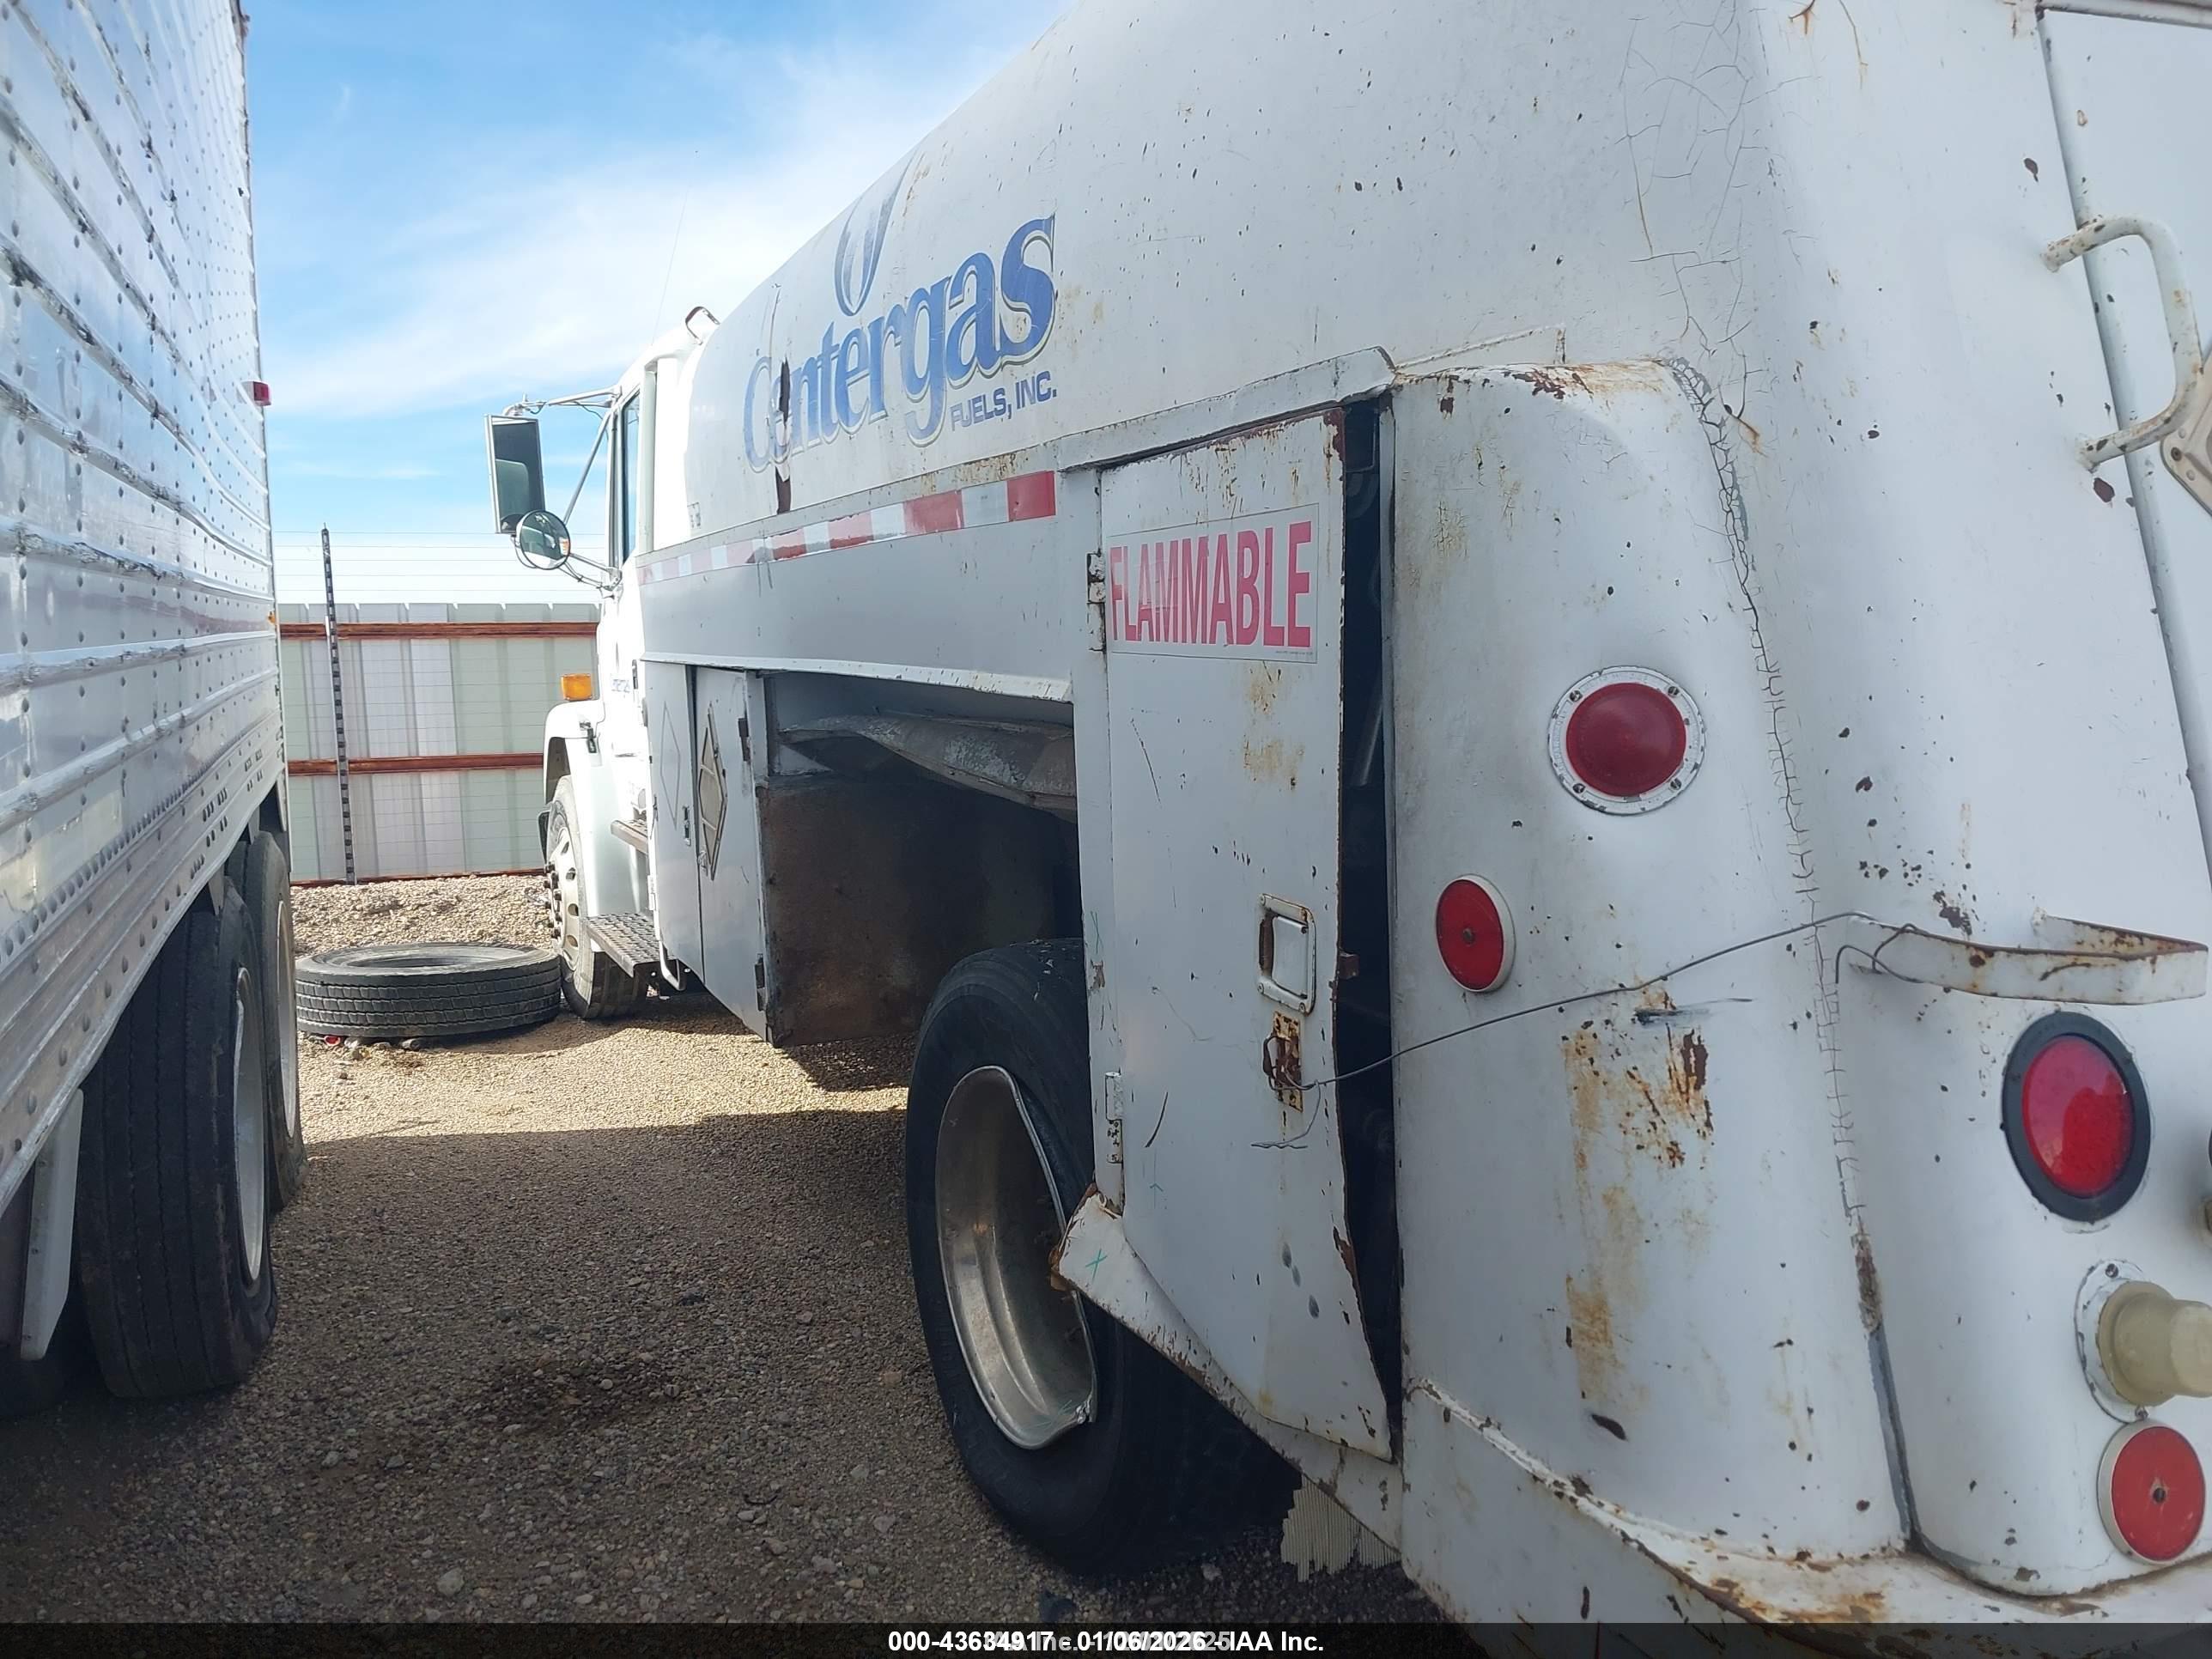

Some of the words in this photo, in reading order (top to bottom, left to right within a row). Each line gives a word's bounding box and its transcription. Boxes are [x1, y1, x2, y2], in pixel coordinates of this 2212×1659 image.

[950, 387, 1012, 431] FUELS,
[1016, 371, 1057, 410] INC.
[1109, 520, 1312, 647] FLAMMABLE
